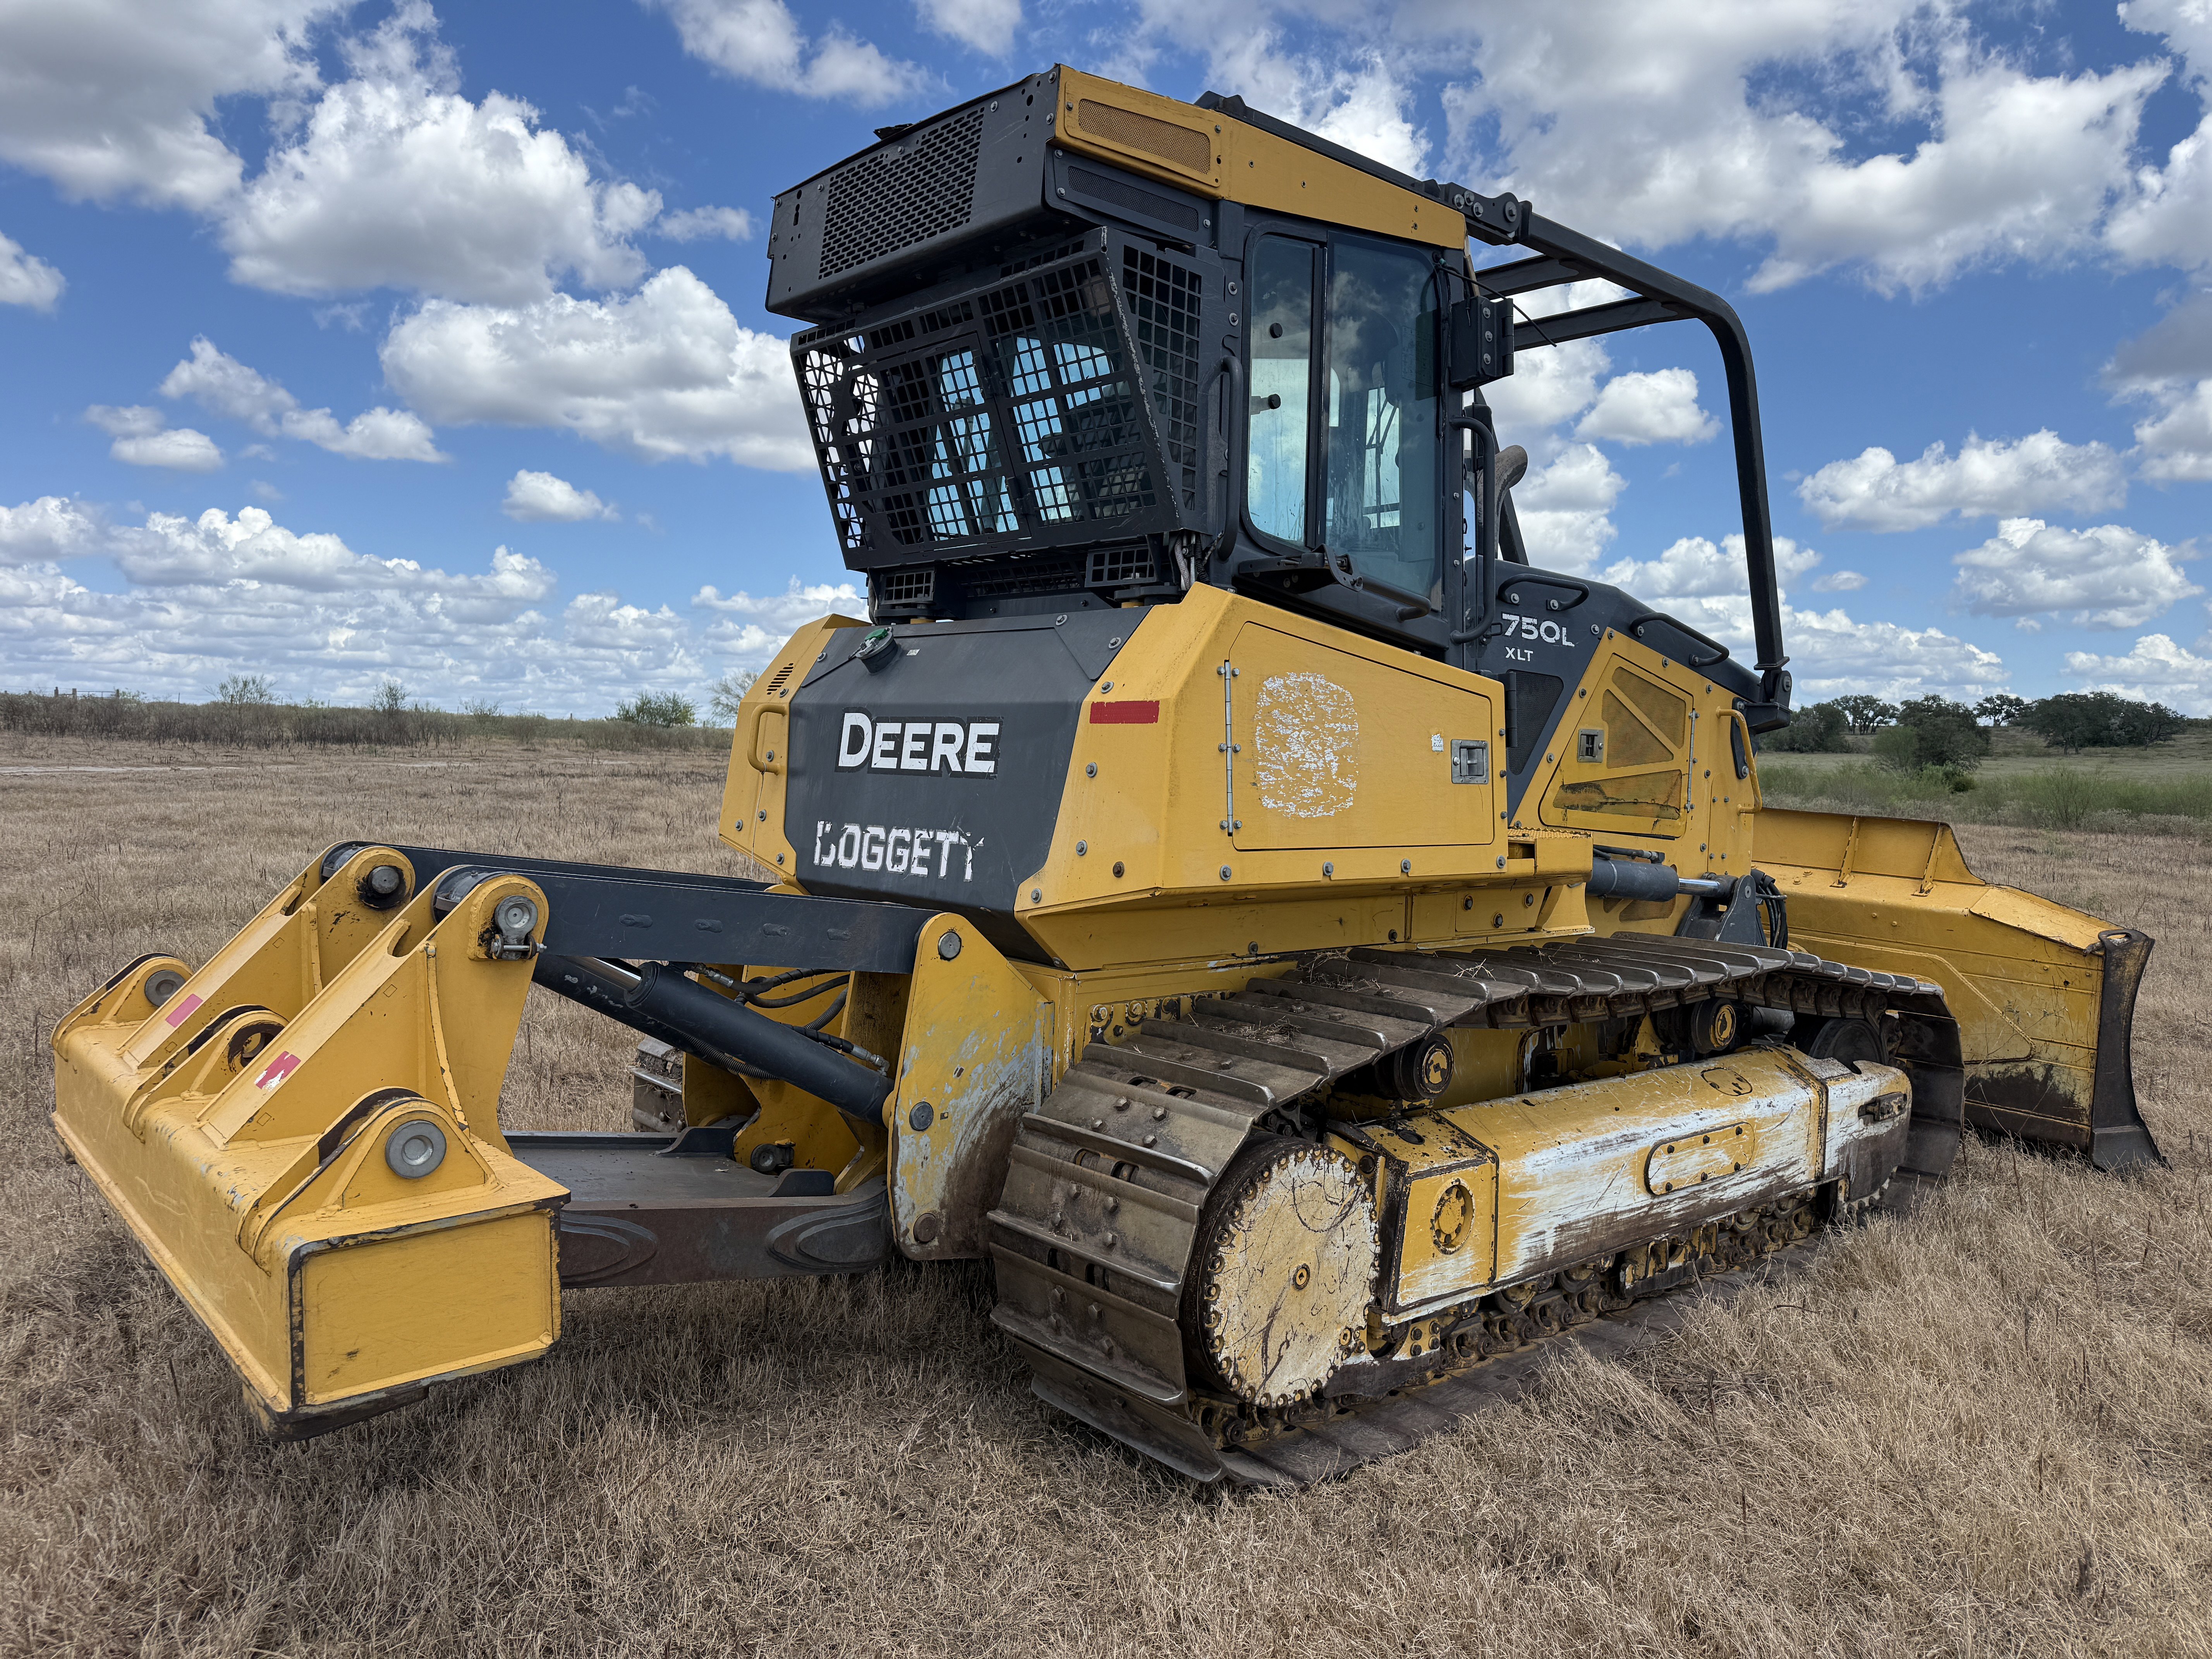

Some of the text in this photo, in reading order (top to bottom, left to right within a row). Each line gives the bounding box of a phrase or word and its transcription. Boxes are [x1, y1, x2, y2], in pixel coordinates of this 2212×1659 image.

[1502, 613, 1575, 647] 750L
[1505, 646, 1534, 661] XLT
[838, 713, 1000, 773] DEERE
